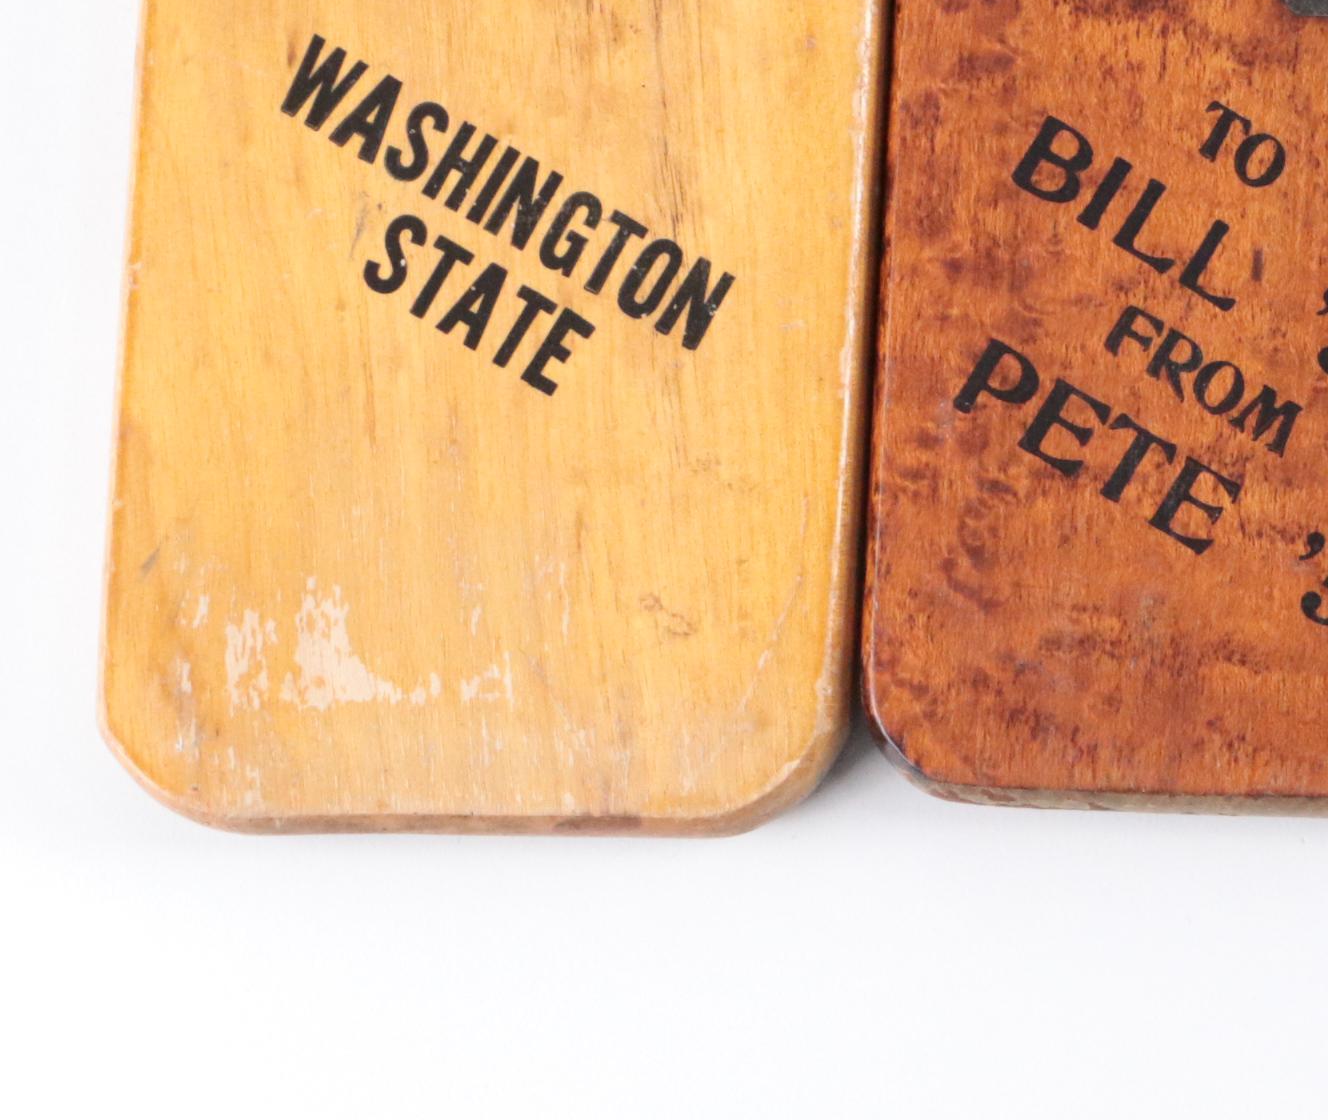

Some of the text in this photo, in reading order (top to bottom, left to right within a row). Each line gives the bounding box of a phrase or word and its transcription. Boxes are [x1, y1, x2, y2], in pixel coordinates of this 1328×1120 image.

[280, 34, 735, 351] WASHINGTON
[1011, 115, 1236, 311] BILL
[1199, 101, 1286, 187] TO
[364, 214, 595, 397] STATE
[1103, 304, 1302, 456] FROM
[953, 337, 1244, 554] PETE
